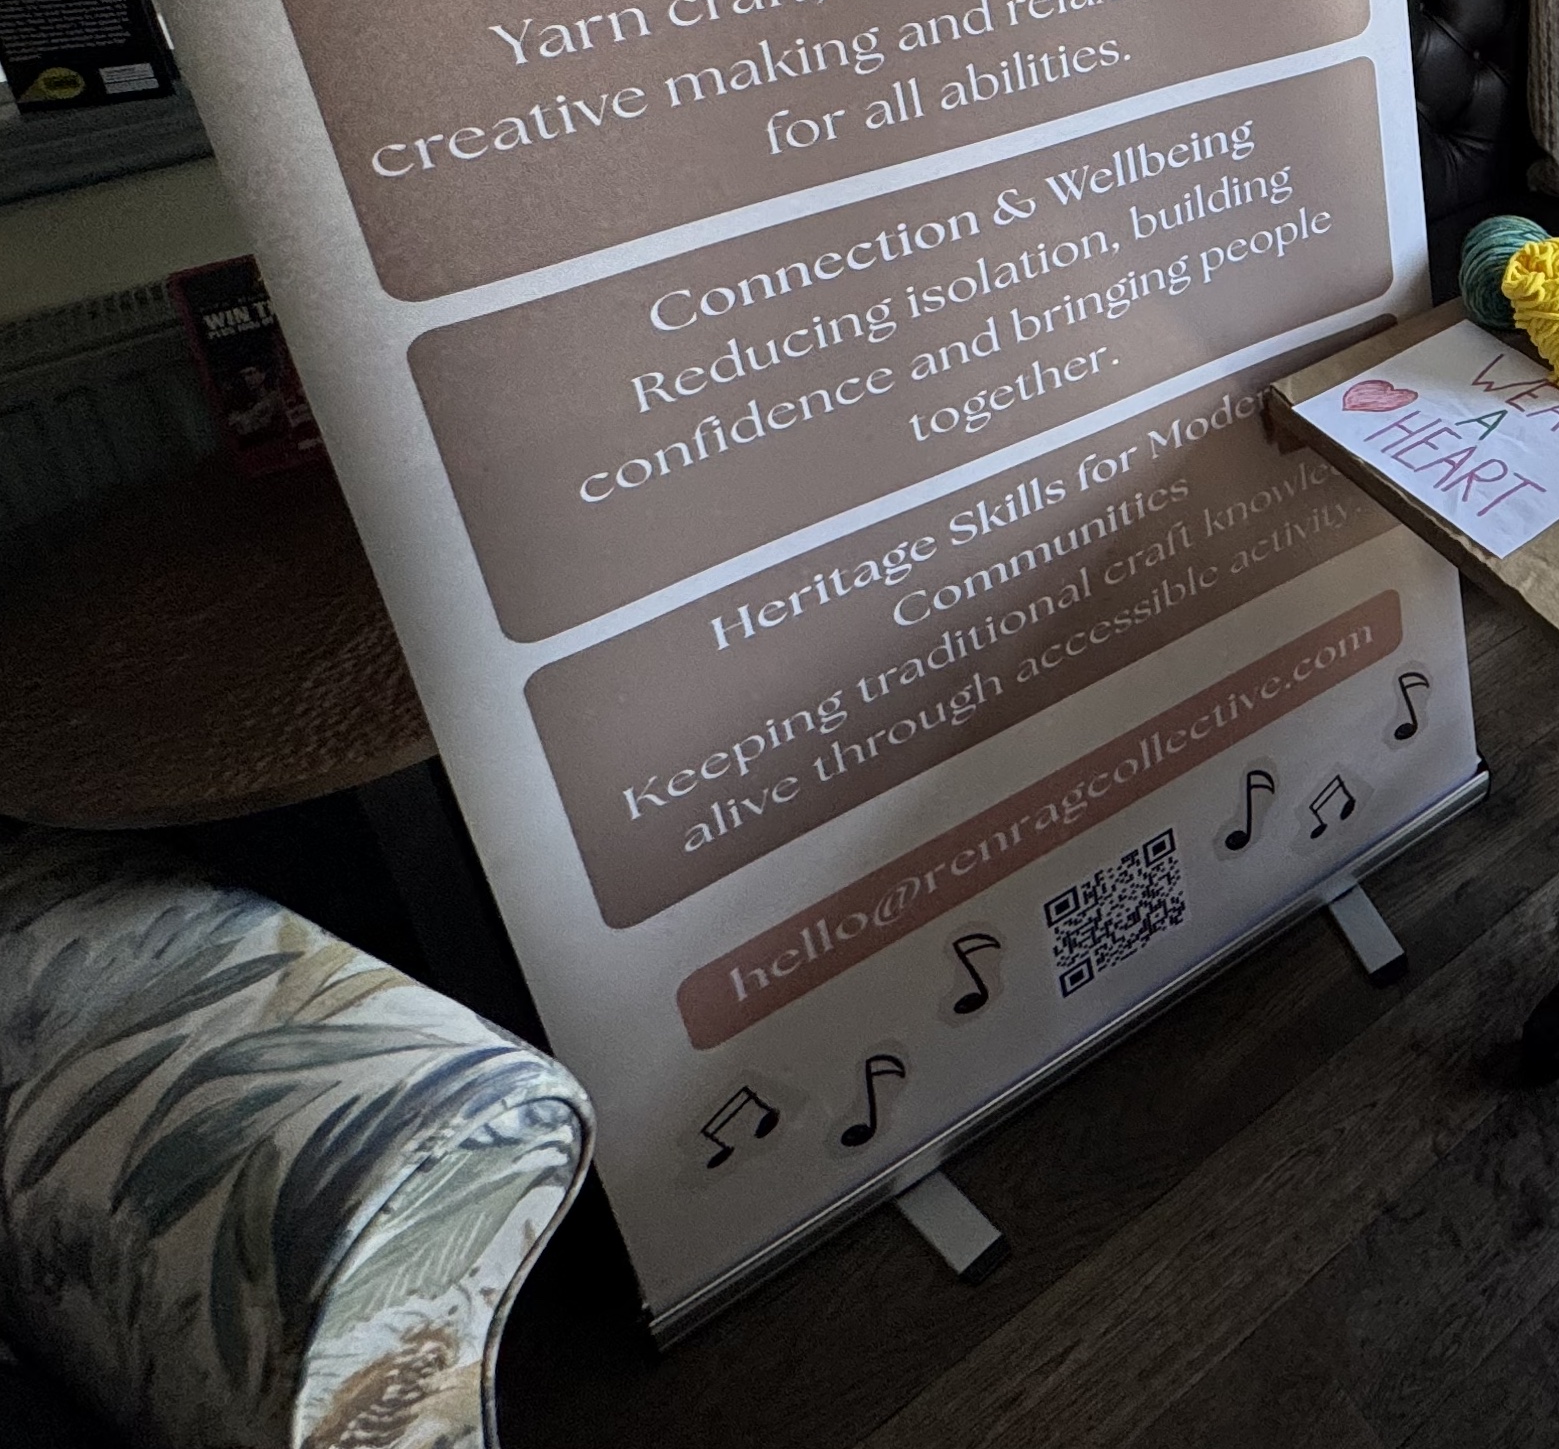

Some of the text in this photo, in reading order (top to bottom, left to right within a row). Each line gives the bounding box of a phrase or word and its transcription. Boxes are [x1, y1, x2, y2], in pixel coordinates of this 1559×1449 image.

[369, 83, 649, 179] creative
[668, 23, 887, 108] making
[487, 0, 652, 67] Yarn
[764, 46, 1133, 156] for all abilities.
[630, 166, 1294, 415] Reducing isolation, building
[648, 120, 1257, 333] Connection & Wellbeing
[578, 206, 1333, 505] confidence and bringing people
[908, 345, 1121, 443] together.
[1455, 409, 1508, 441] A
[708, 387, 1270, 652] Heritage Skills for Moder
[892, 473, 1190, 628] Communities
[1363, 410, 1547, 517] HEART
[622, 460, 1341, 821] Keeping traditional craft knowle
[683, 774, 801, 853] alive
[813, 672, 1004, 784] through
[1016, 556, 1219, 685] accessible
[730, 621, 1374, 1002] hello@renragcollective.com
